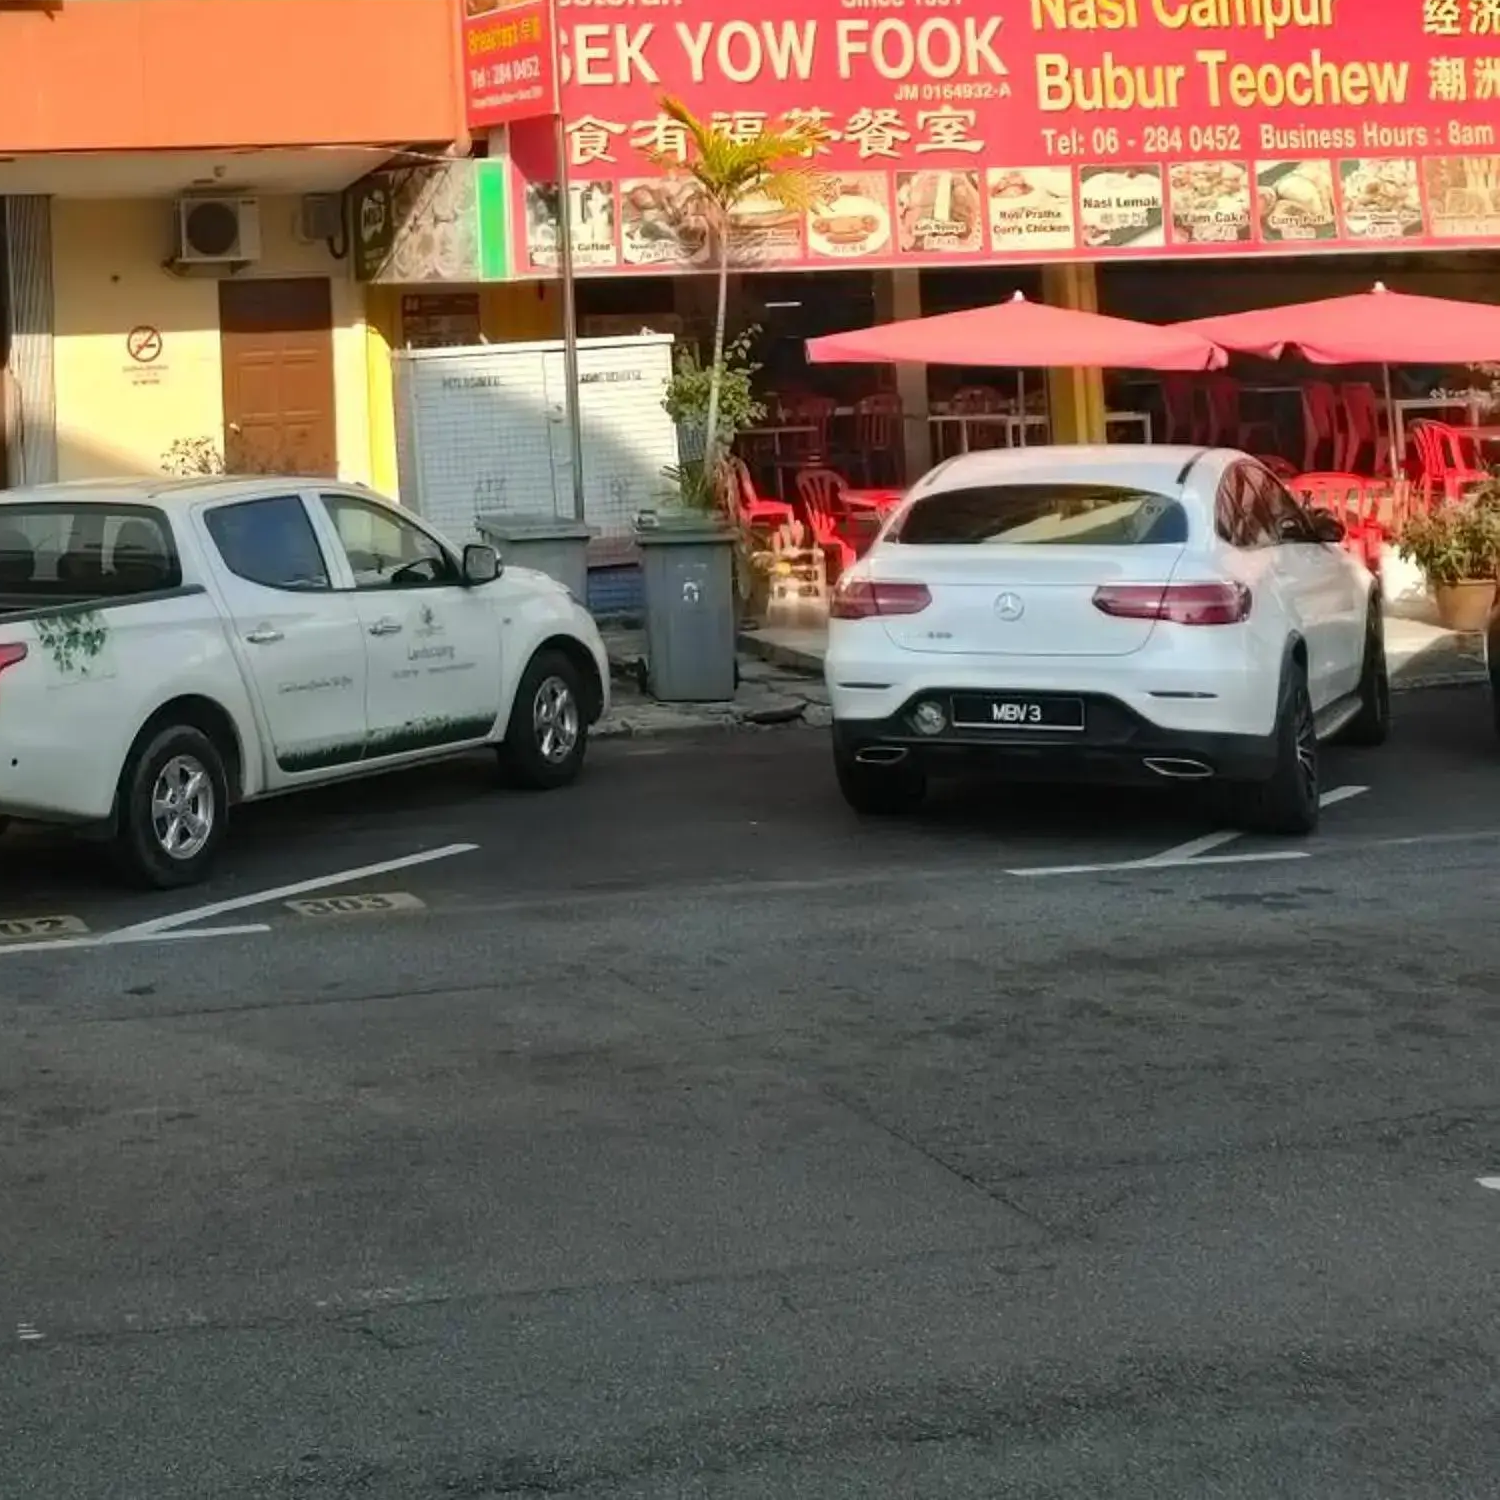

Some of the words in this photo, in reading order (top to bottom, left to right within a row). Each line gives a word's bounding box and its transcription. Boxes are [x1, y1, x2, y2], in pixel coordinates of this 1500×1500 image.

[675, 19, 817, 84] YOW
[837, 16, 1009, 81] FOOK
[894, 84, 919, 101] JM
[1036, 52, 1184, 112] Bubur
[1197, 48, 1409, 108] Teochew
[1092, 128, 1119, 155] 06
[1144, 126, 1182, 153] 284
[1189, 125, 1240, 152] 0452
[1260, 123, 1355, 150] Business
[1363, 121, 1428, 148] Hours
[1448, 120, 1494, 147] 8am
[1083, 197, 1112, 209] Nasi
[1116, 196, 1159, 208] Lemak
